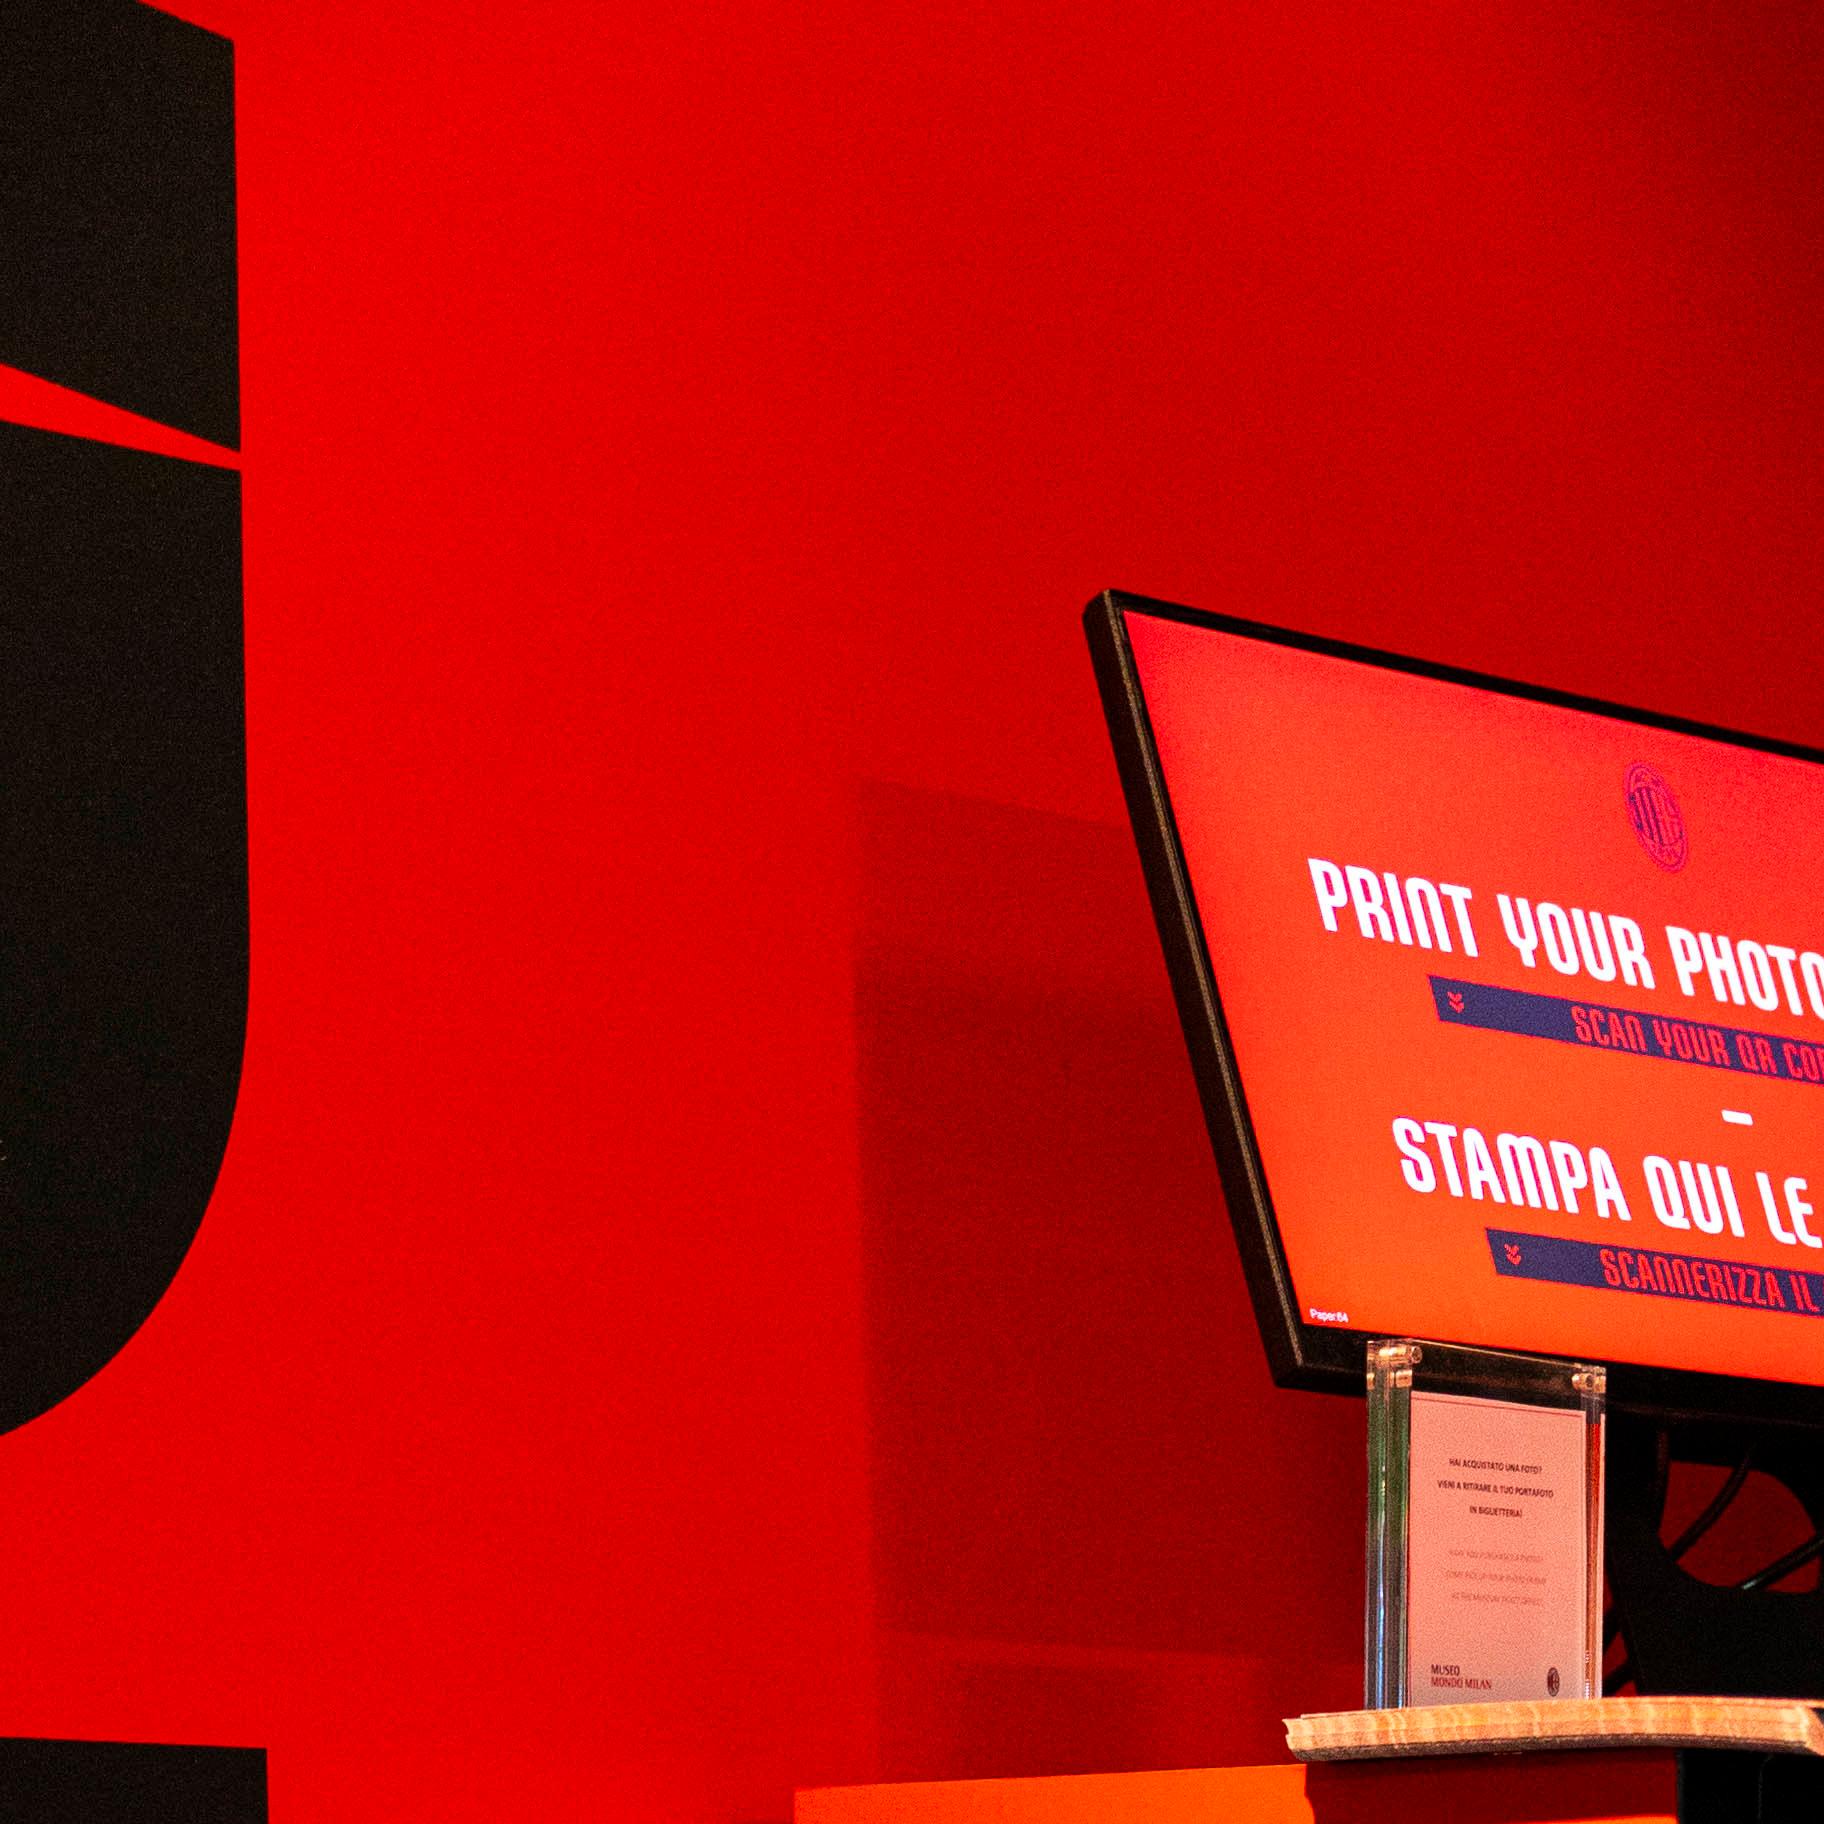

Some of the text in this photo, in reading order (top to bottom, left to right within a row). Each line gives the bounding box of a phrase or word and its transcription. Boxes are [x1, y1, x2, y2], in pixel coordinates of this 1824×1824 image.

[1307, 858, 1478, 957] PRINT
[1496, 894, 1655, 989] YOUR
[1571, 1005, 1647, 1053] SCAN
[1652, 1019, 1730, 1067] YOUR
[1735, 1034, 1778, 1075] QR
[1392, 1117, 1632, 1221] STAMPA
[1642, 1155, 1745, 1237] QUI
[1755, 1171, 1823, 1248] LE
[1599, 1247, 1786, 1308] SCANNERIZZA
[1788, 1273, 1819, 1313] IL
[1462, 1459, 1504, 1471] ACQUISTATO
[1505, 1464, 1520, 1473] UNA
[1437, 1480, 1455, 1489] VIENI
[1456, 1481, 1461, 1489] A
[1463, 1482, 1491, 1493] RITIRARE
[1500, 1486, 1514, 1495] TUO
[1515, 1487, 1554, 1498] PORTAFOTO
[1469, 1505, 1477, 1514] IN
[1431, 1664, 1460, 1676] MUSEO
[1431, 1677, 1492, 1690] MONDO MILAN
